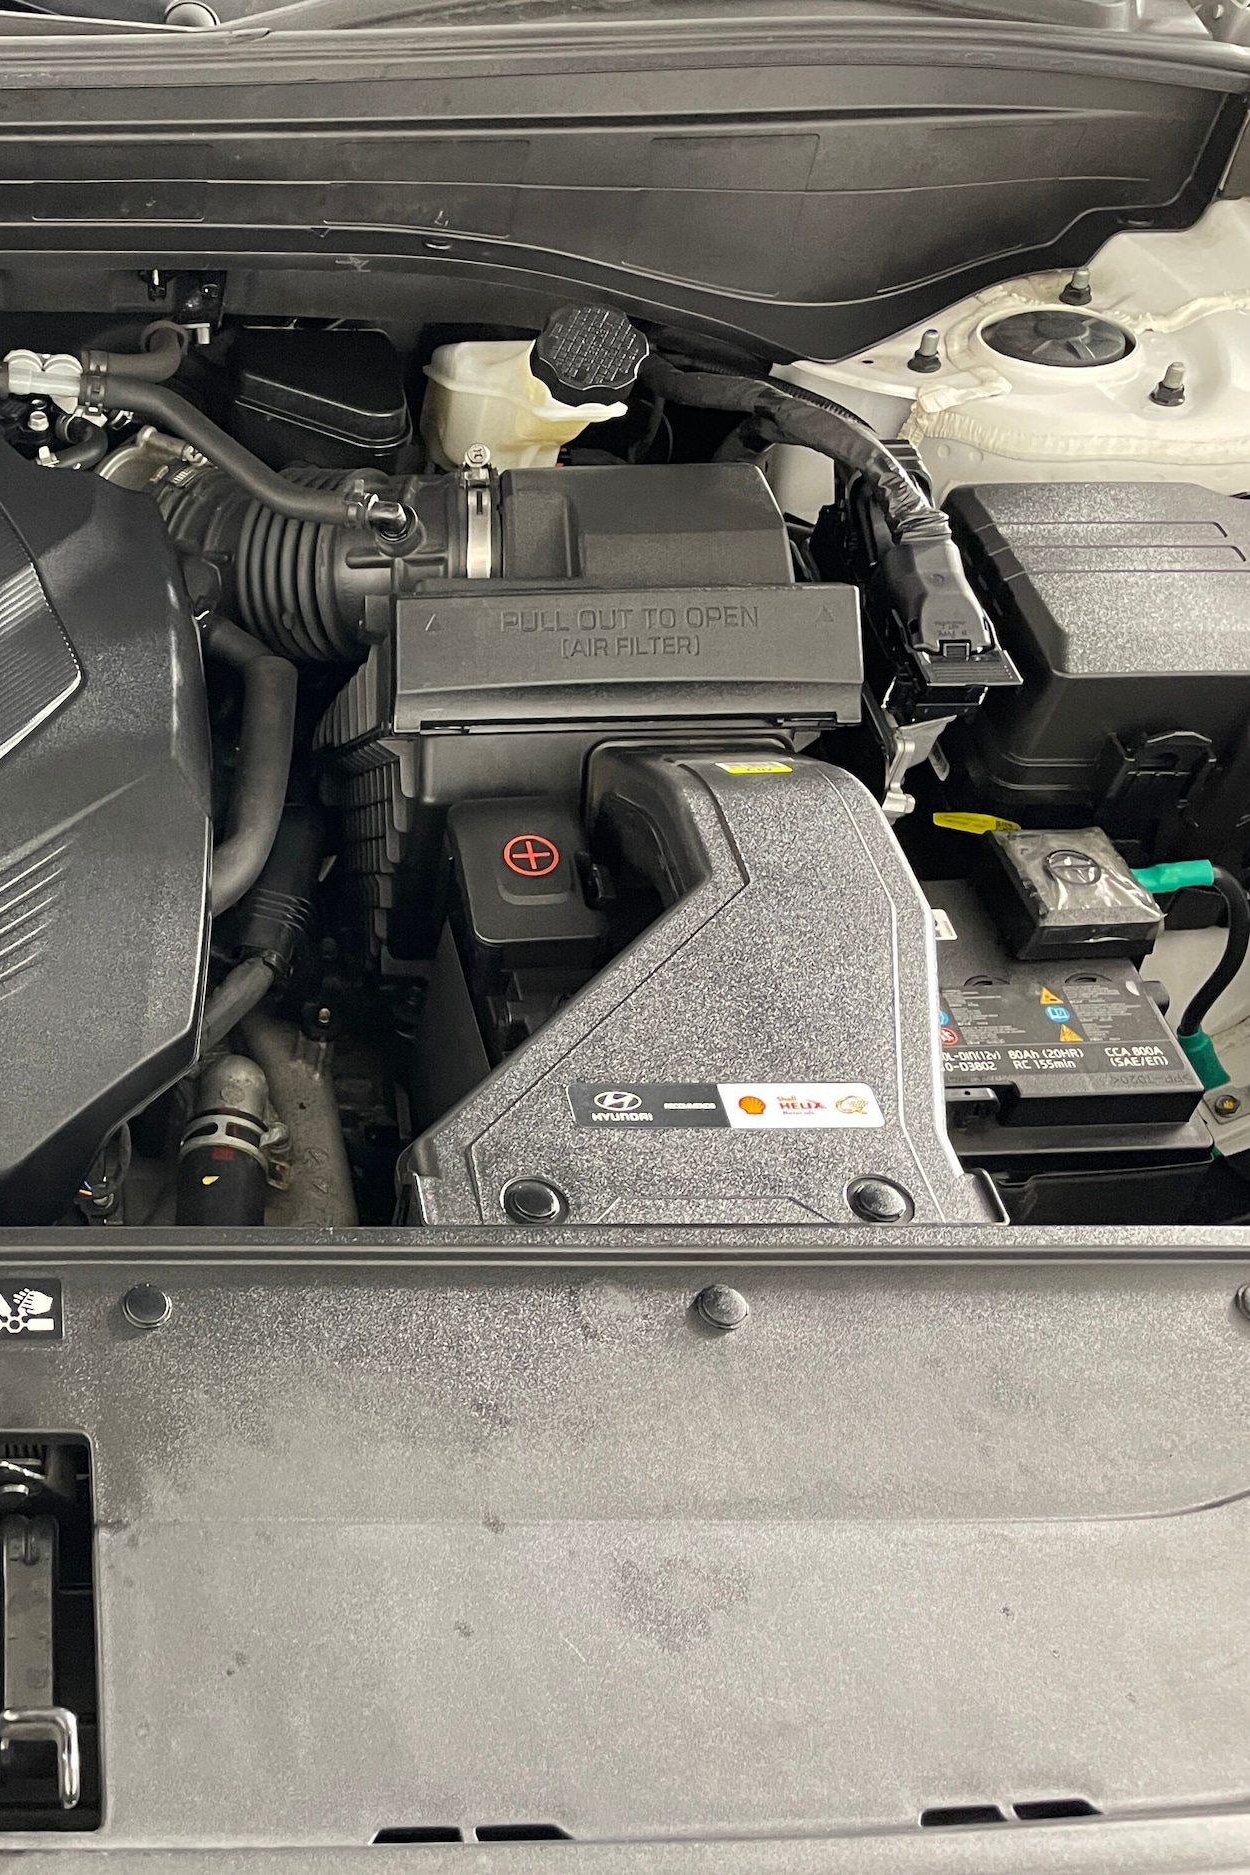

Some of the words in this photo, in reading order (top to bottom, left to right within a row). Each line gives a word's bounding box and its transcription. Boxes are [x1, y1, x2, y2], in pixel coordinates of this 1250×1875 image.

[500, 610, 570, 632] PULL
[577, 608, 633, 631] OUT
[642, 607, 676, 629] TO
[684, 605, 759, 629] OPEN
[1008, 1050, 1040, 1060] 80Ah
[1043, 1048, 1084, 1059] (20HR)
[1104, 1048, 1131, 1057] CCA
[1131, 1047, 1164, 1056] 800A
[1013, 1061, 1032, 1070] RC
[1034, 1059, 1076, 1069] 155min
[779, 1099, 829, 1110] HELIX
[591, 1112, 654, 1122] HYUNDAI
